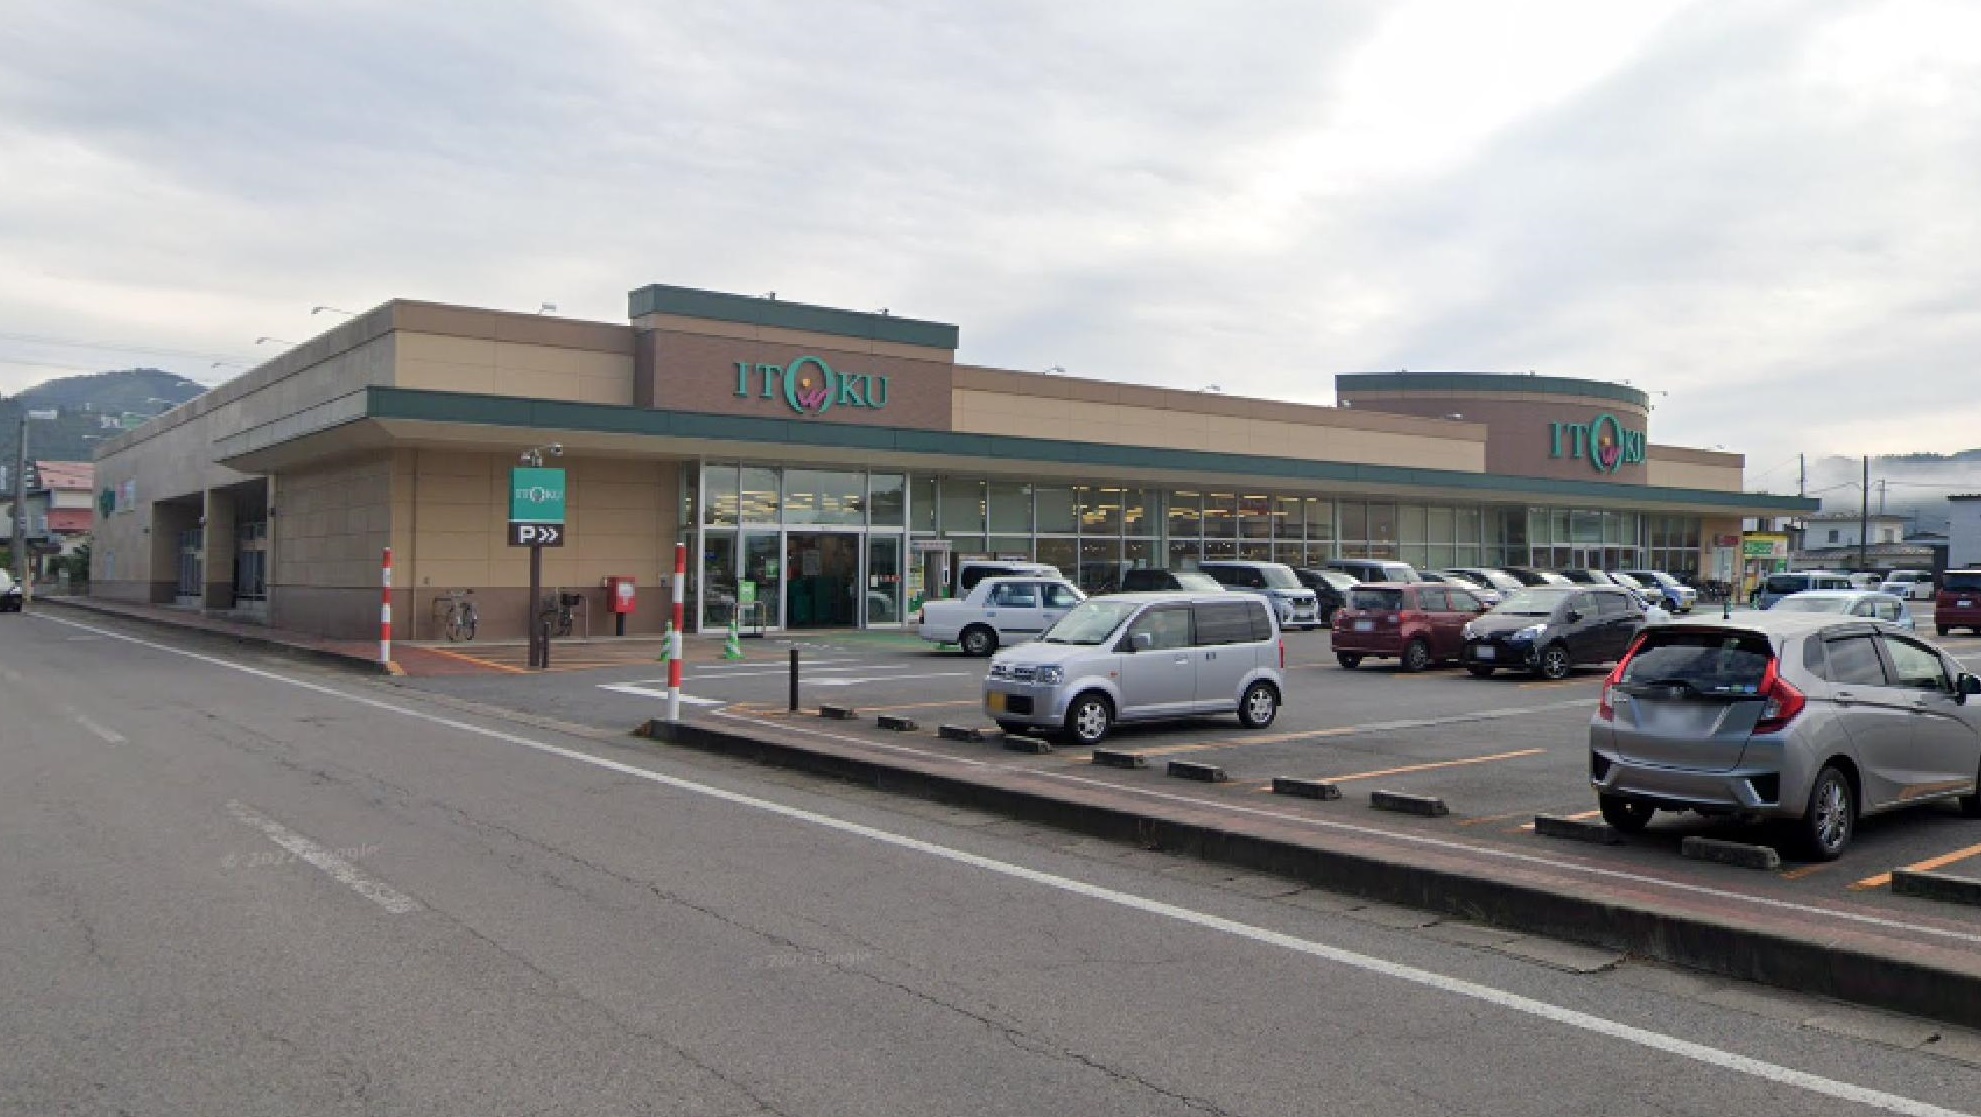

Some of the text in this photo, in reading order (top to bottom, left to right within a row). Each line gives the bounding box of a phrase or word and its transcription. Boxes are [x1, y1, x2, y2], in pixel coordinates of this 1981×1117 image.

[733, 355, 889, 416] ITOKU
[1548, 412, 1647, 475] ITOKU
[518, 525, 536, 543] P
